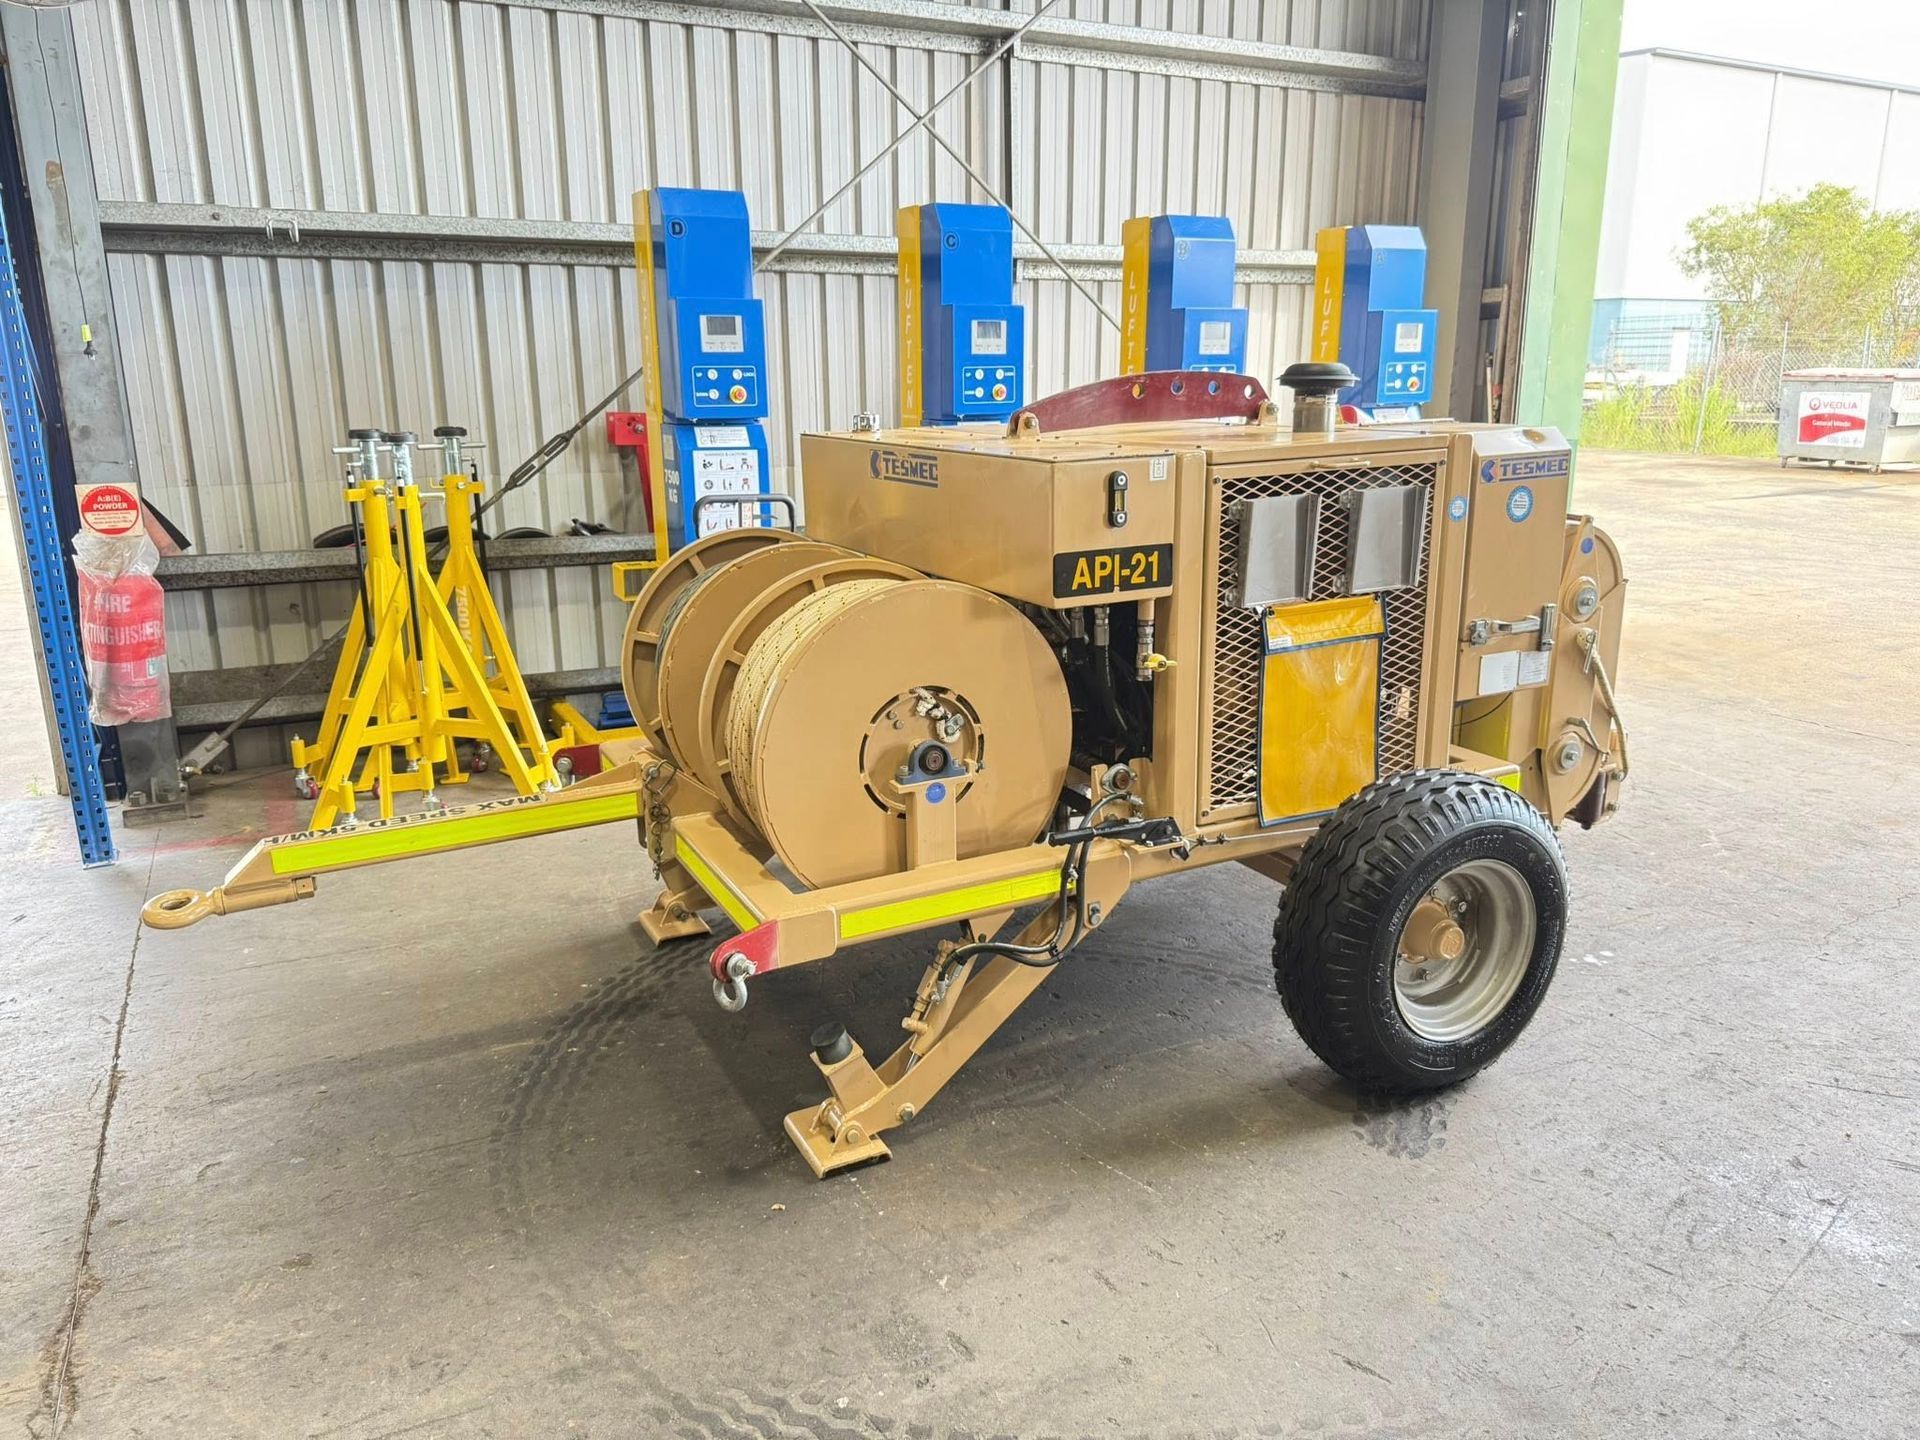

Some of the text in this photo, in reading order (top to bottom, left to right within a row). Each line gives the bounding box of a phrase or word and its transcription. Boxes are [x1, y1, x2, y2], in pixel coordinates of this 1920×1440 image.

[670, 220, 684, 236] D
[945, 234, 957, 248] C
[1126, 271, 1138, 376] LUFTE
[1320, 276, 1333, 359] LUFT
[1822, 400, 1858, 410] VEOLIA
[663, 468, 681, 486] 7500
[882, 456, 939, 482] TESMEC
[1499, 458, 1569, 477] TESMEC
[92, 502, 129, 511] POWDER
[1071, 550, 1159, 591] API-21
[95, 592, 132, 614] FIRE
[263, 794, 541, 844] MAX SPEED 5KM/H
